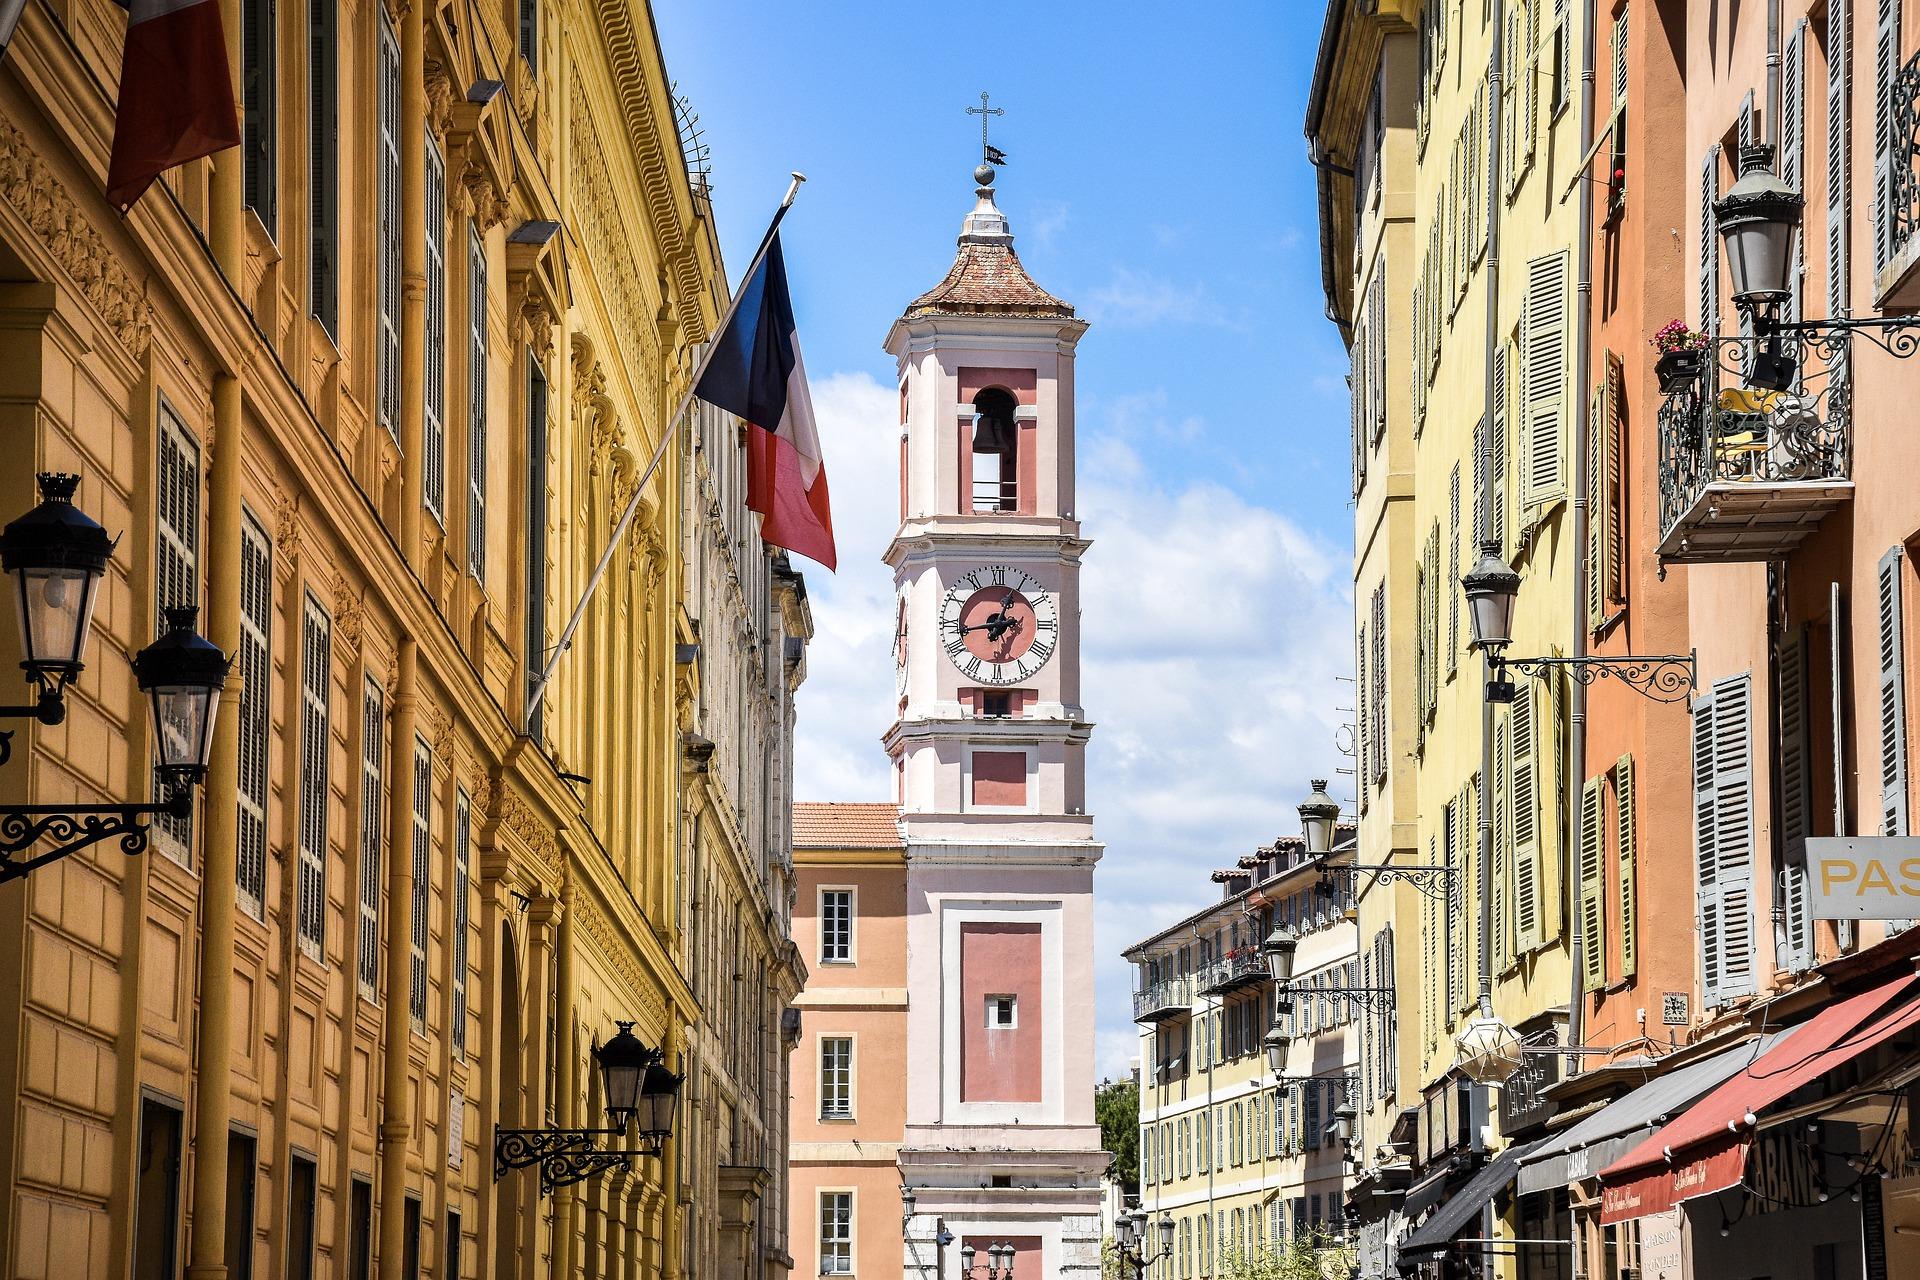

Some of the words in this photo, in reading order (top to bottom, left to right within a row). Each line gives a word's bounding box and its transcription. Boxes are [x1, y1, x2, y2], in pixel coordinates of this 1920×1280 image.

[967, 575, 982, 591] XI
[991, 570, 1005, 585] XII
[1030, 594, 1046, 608] II
[1037, 619, 1053, 631] III
[992, 664, 1002, 679] VI
[1643, 1230, 1675, 1250] MAISON
